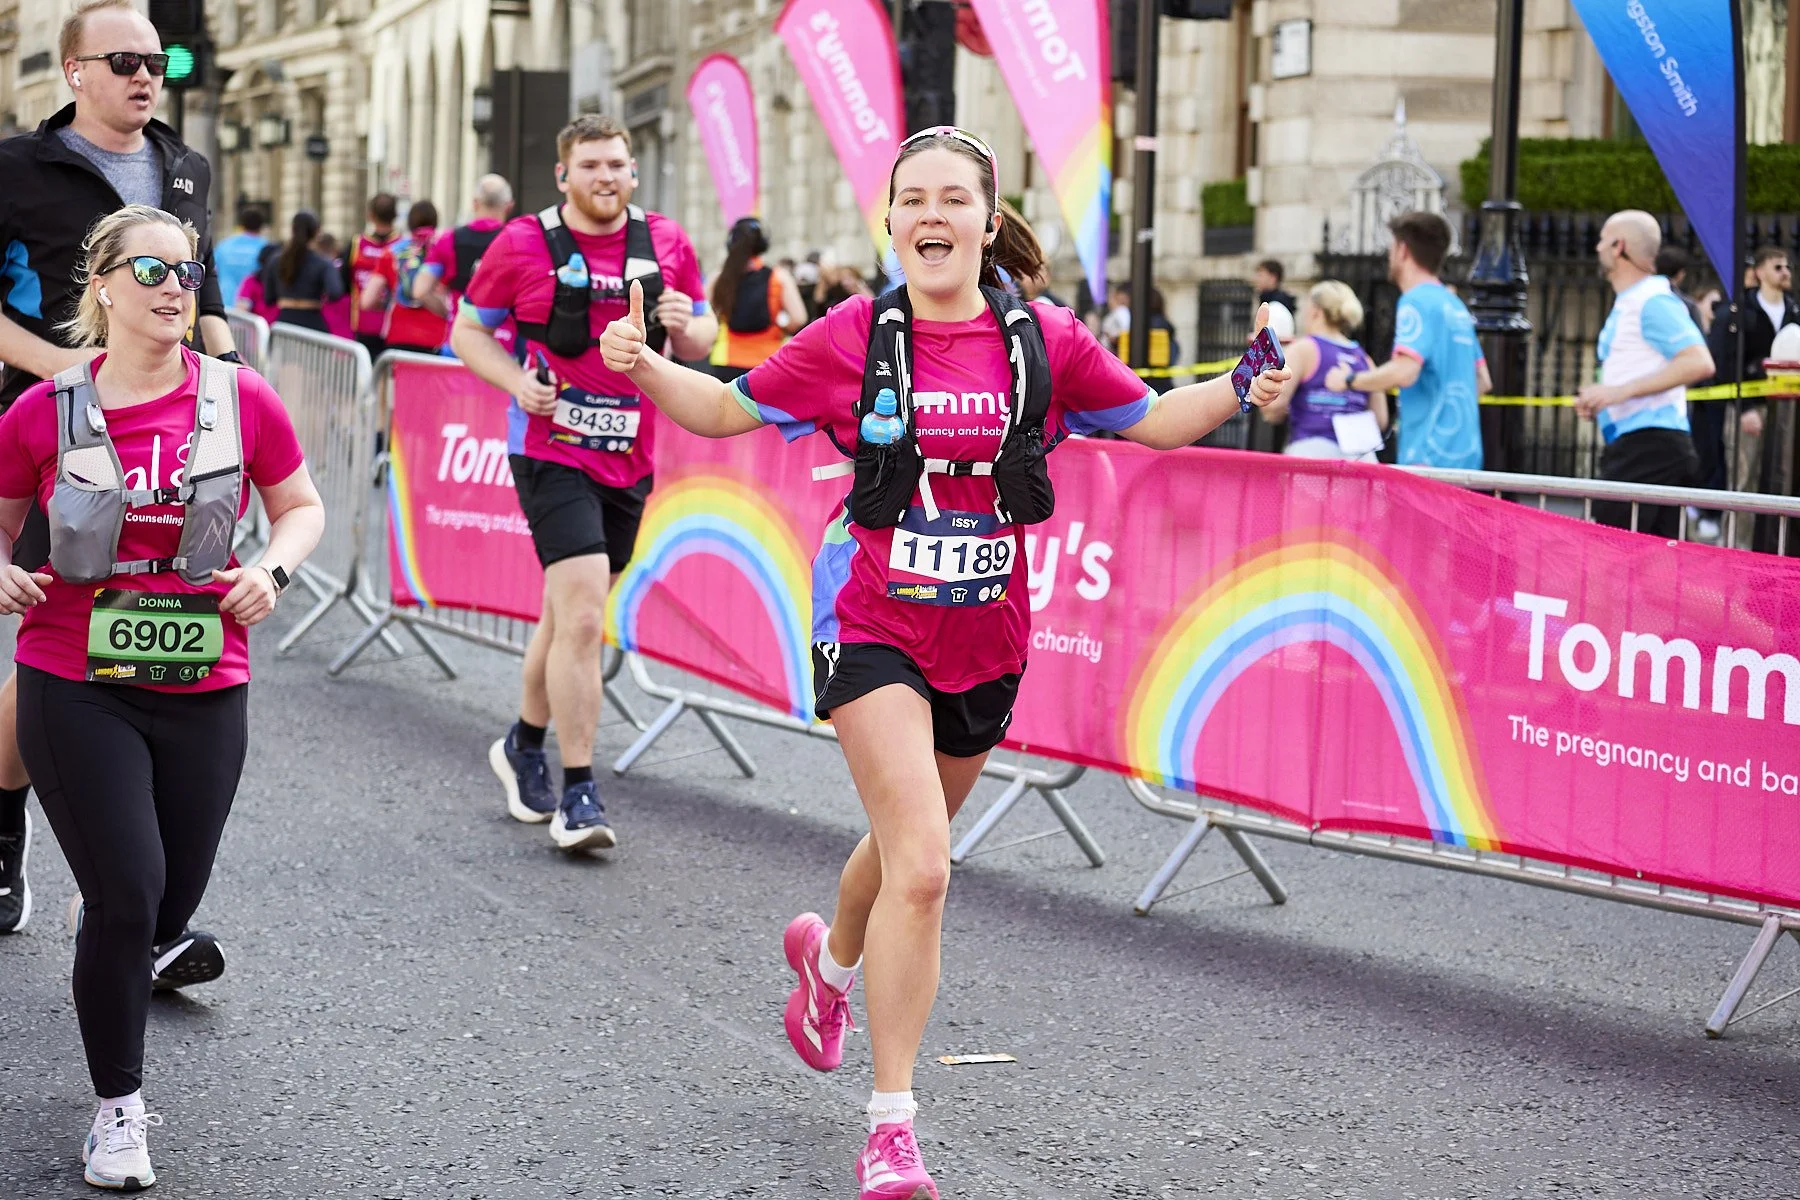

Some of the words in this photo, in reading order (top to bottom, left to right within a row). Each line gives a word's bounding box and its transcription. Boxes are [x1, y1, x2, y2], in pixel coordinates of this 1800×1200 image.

[1626, 0, 1666, 58] gston
[1660, 57, 1698, 117] Smith
[568, 407, 627, 433] 9433
[958, 425, 979, 436] and
[982, 425, 1004, 436] bab
[125, 512, 184, 526] Counselling
[951, 517, 979, 529] ISSY
[903, 536, 1010, 574] 11189
[138, 597, 182, 608] DONNA
[109, 618, 205, 653] 6902
[1032, 626, 1103, 664] charity
[1508, 714, 1549, 748] The
[1555, 730, 1689, 783] pregnancy
[1697, 758, 1750, 788] and
[1761, 761, 1799, 797] ba
